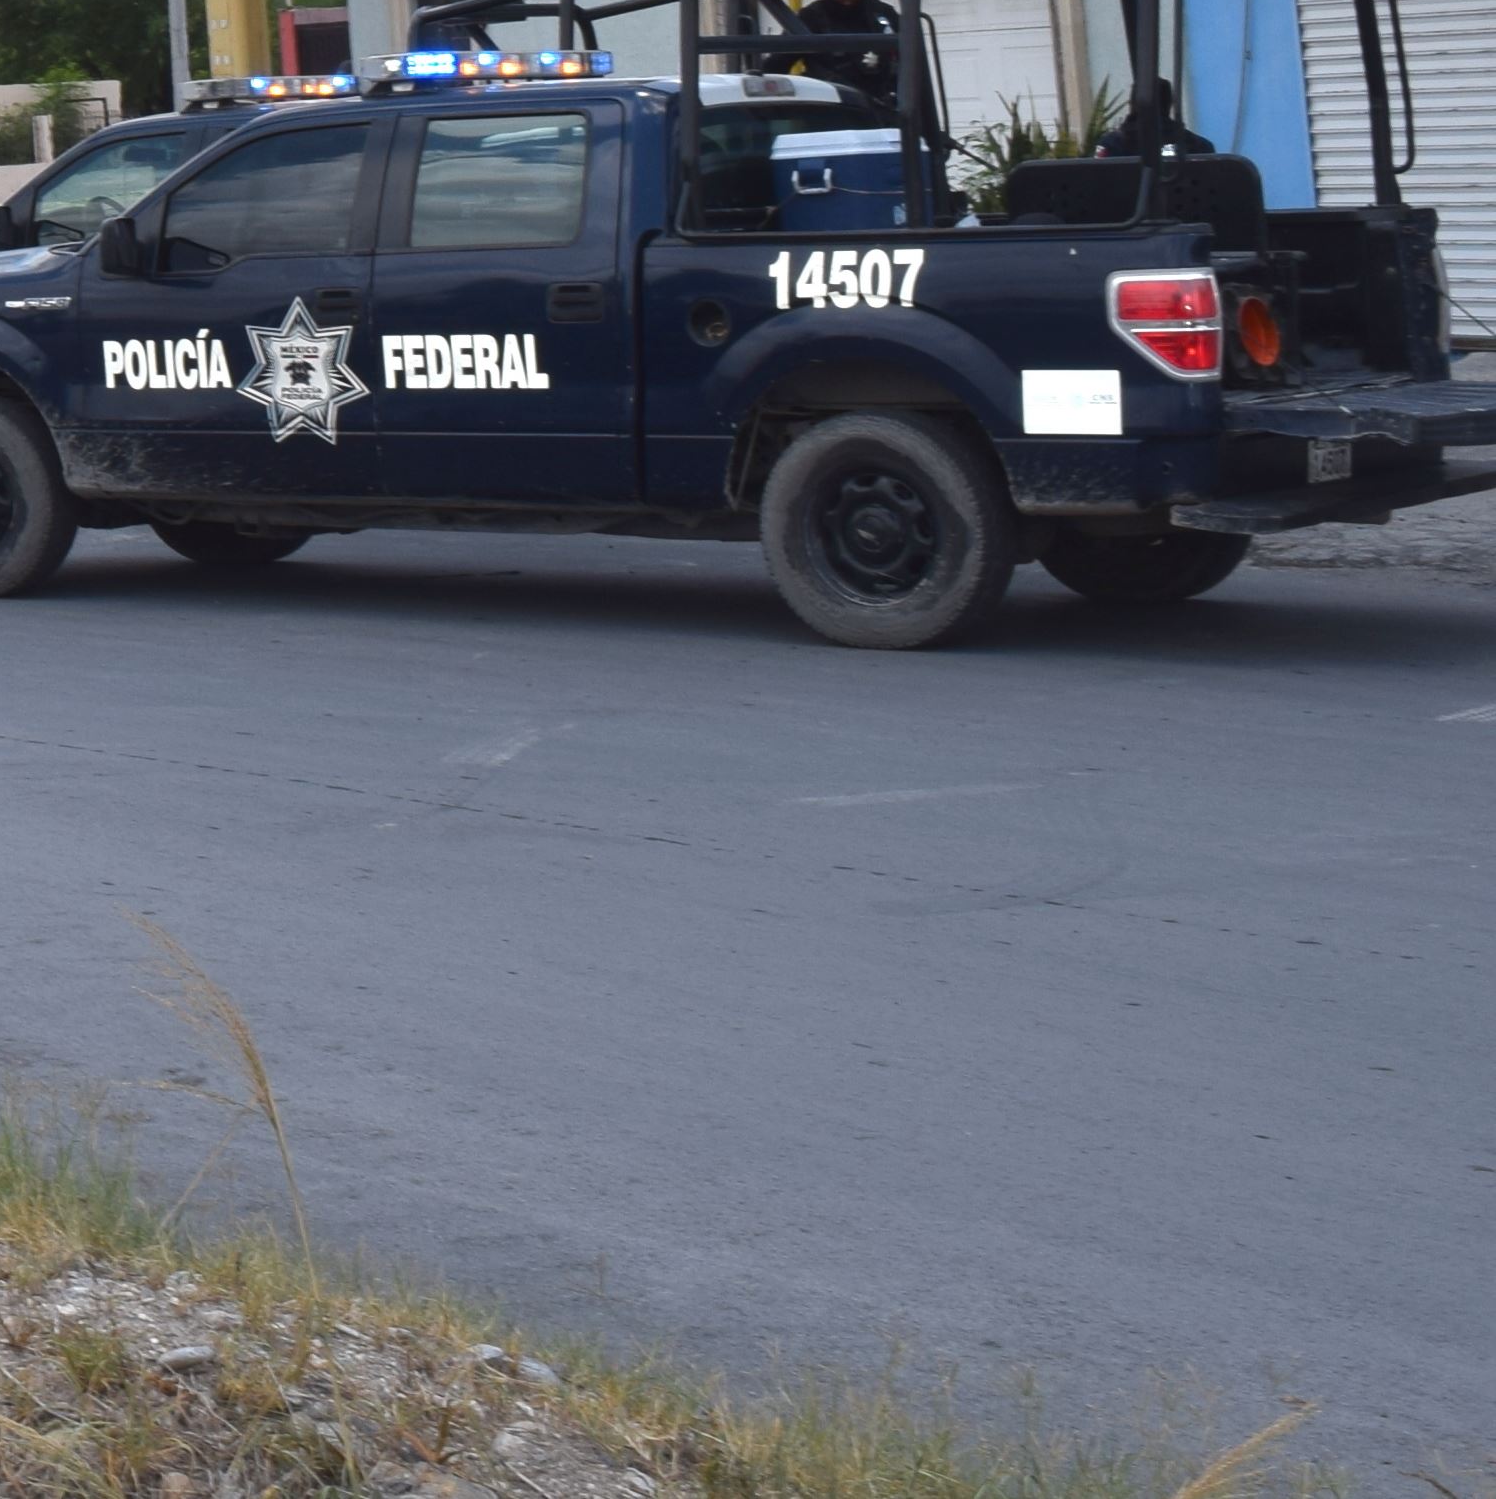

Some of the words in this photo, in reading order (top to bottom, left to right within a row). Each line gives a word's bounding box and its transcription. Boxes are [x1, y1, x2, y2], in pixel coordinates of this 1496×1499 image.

[769, 249, 925, 311] 14507
[102, 328, 233, 390] POLICÍA
[382, 334, 550, 390] FEDERAL
